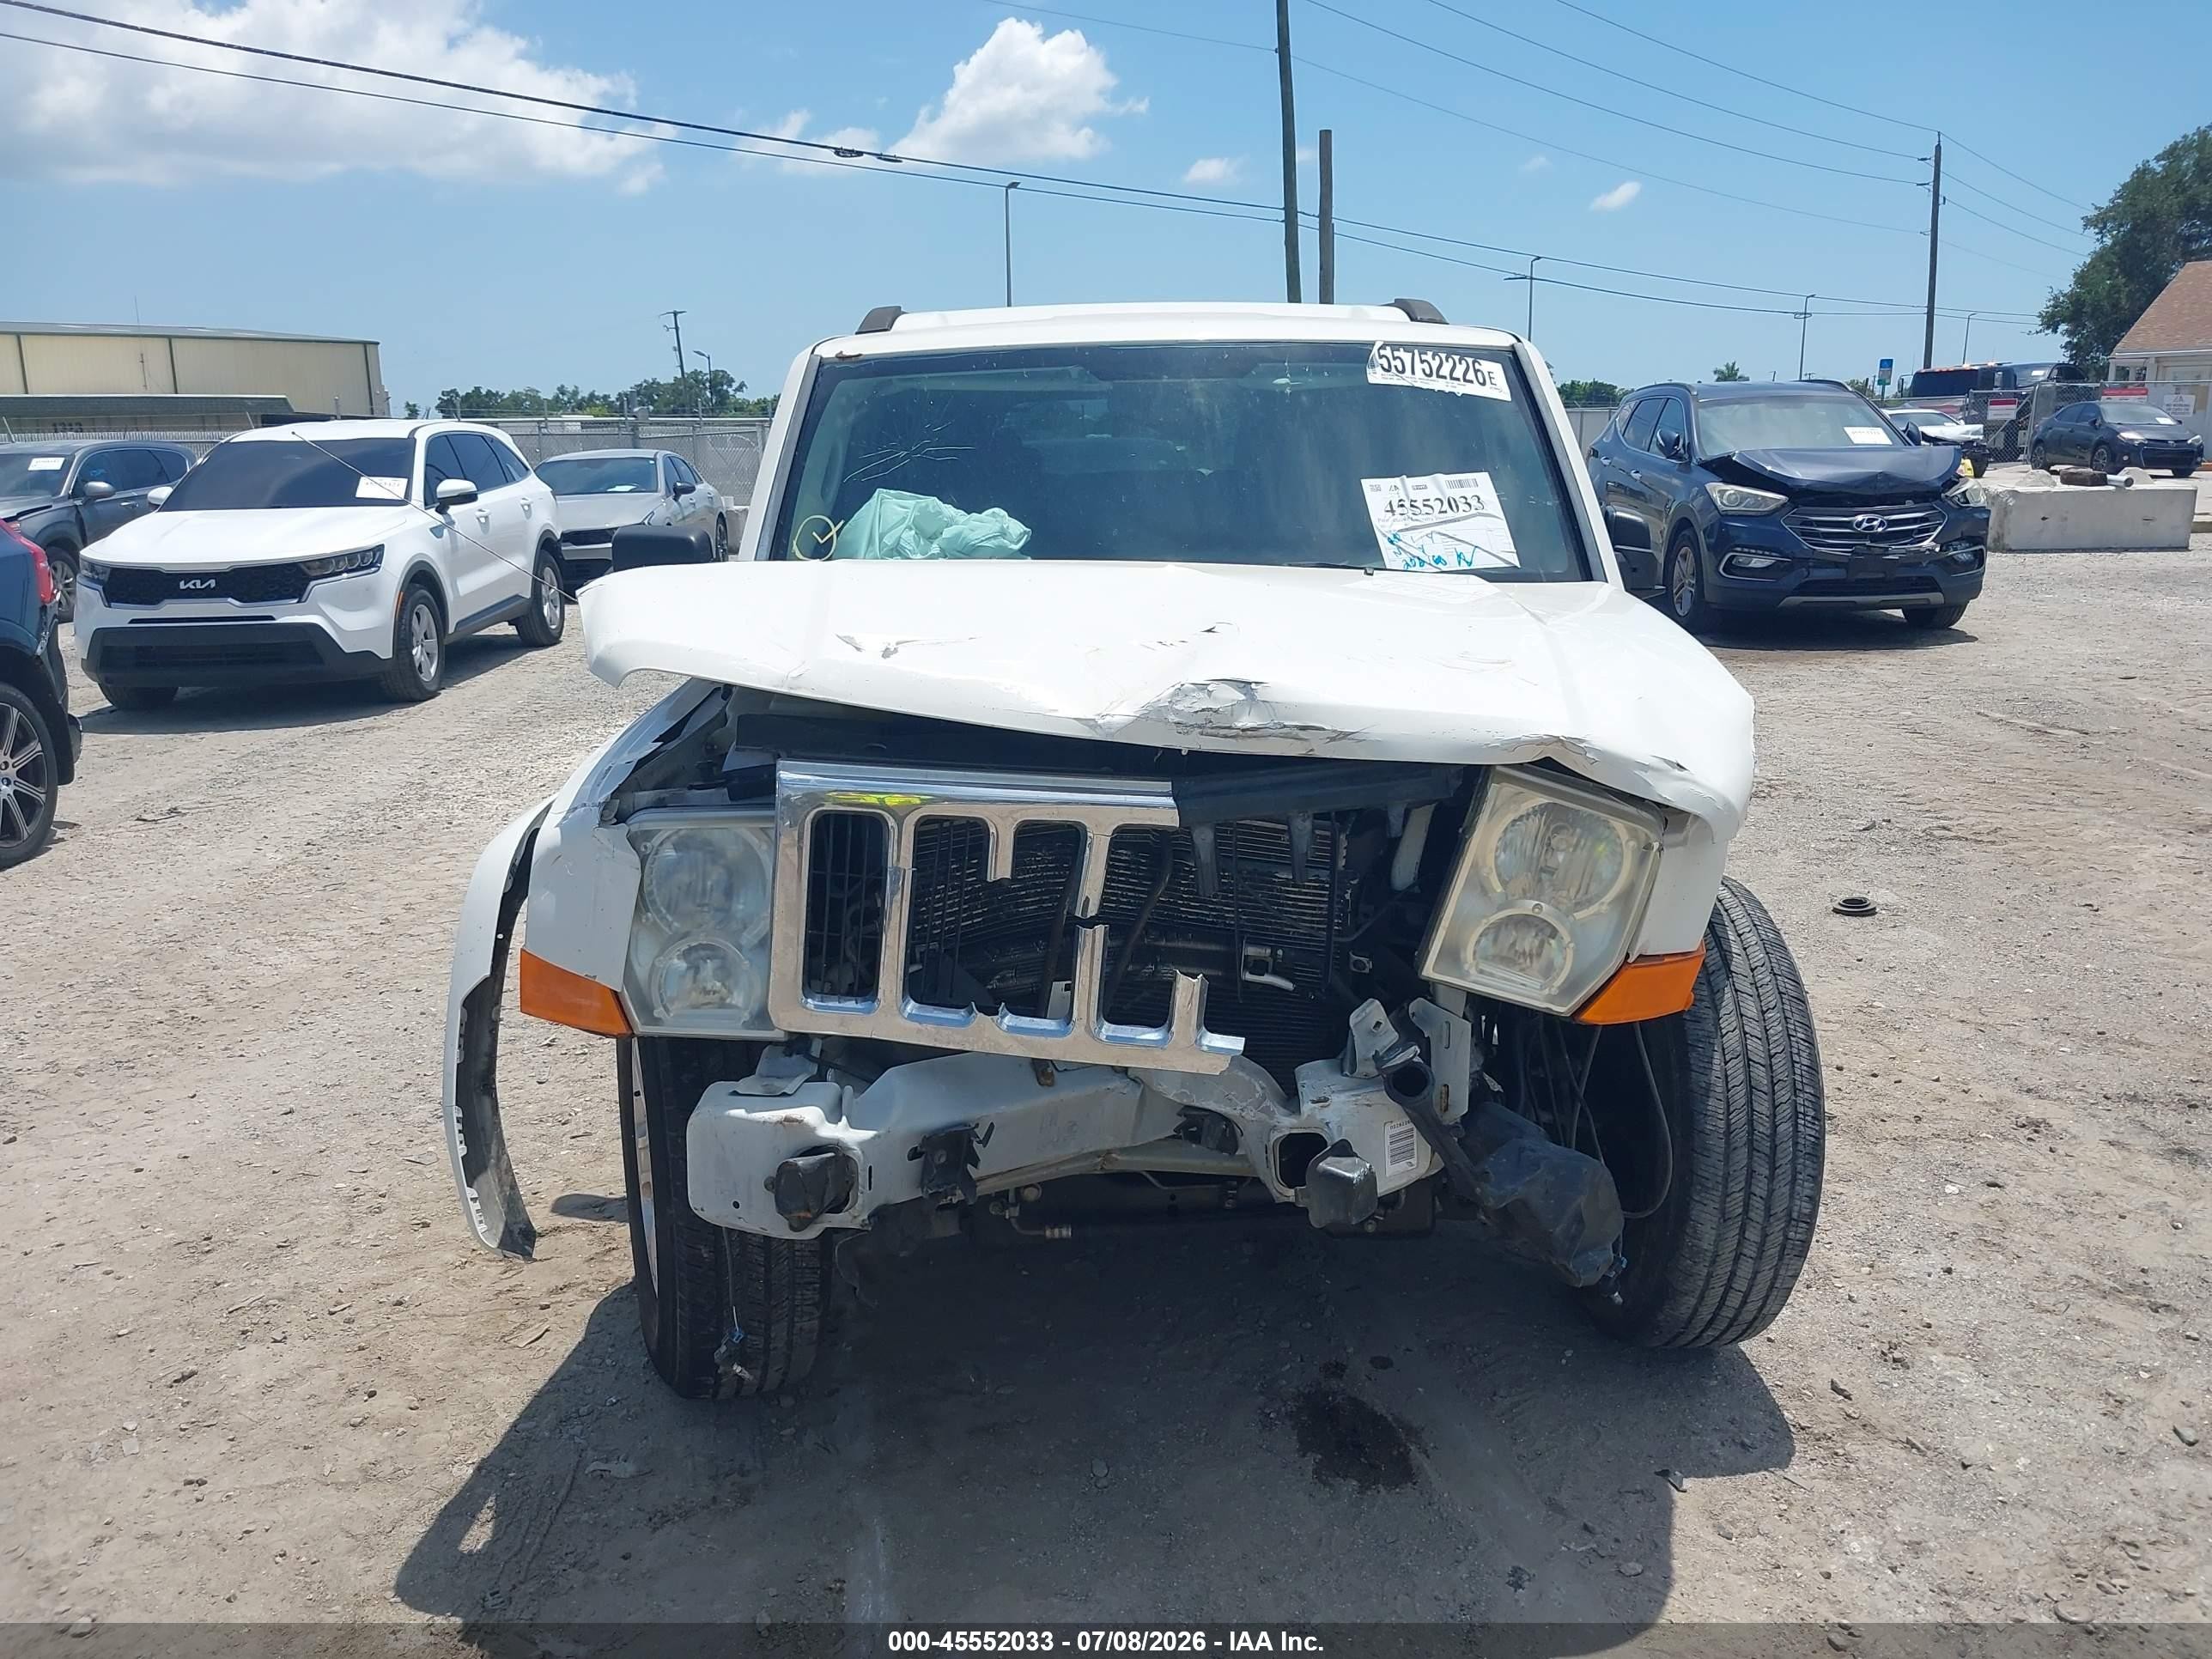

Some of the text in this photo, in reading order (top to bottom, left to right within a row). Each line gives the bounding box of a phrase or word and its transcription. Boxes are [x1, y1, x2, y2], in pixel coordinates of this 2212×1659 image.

[1488, 371, 1498, 386] E
[1384, 494, 1485, 516] 45552033
[179, 579, 216, 589] KIA
